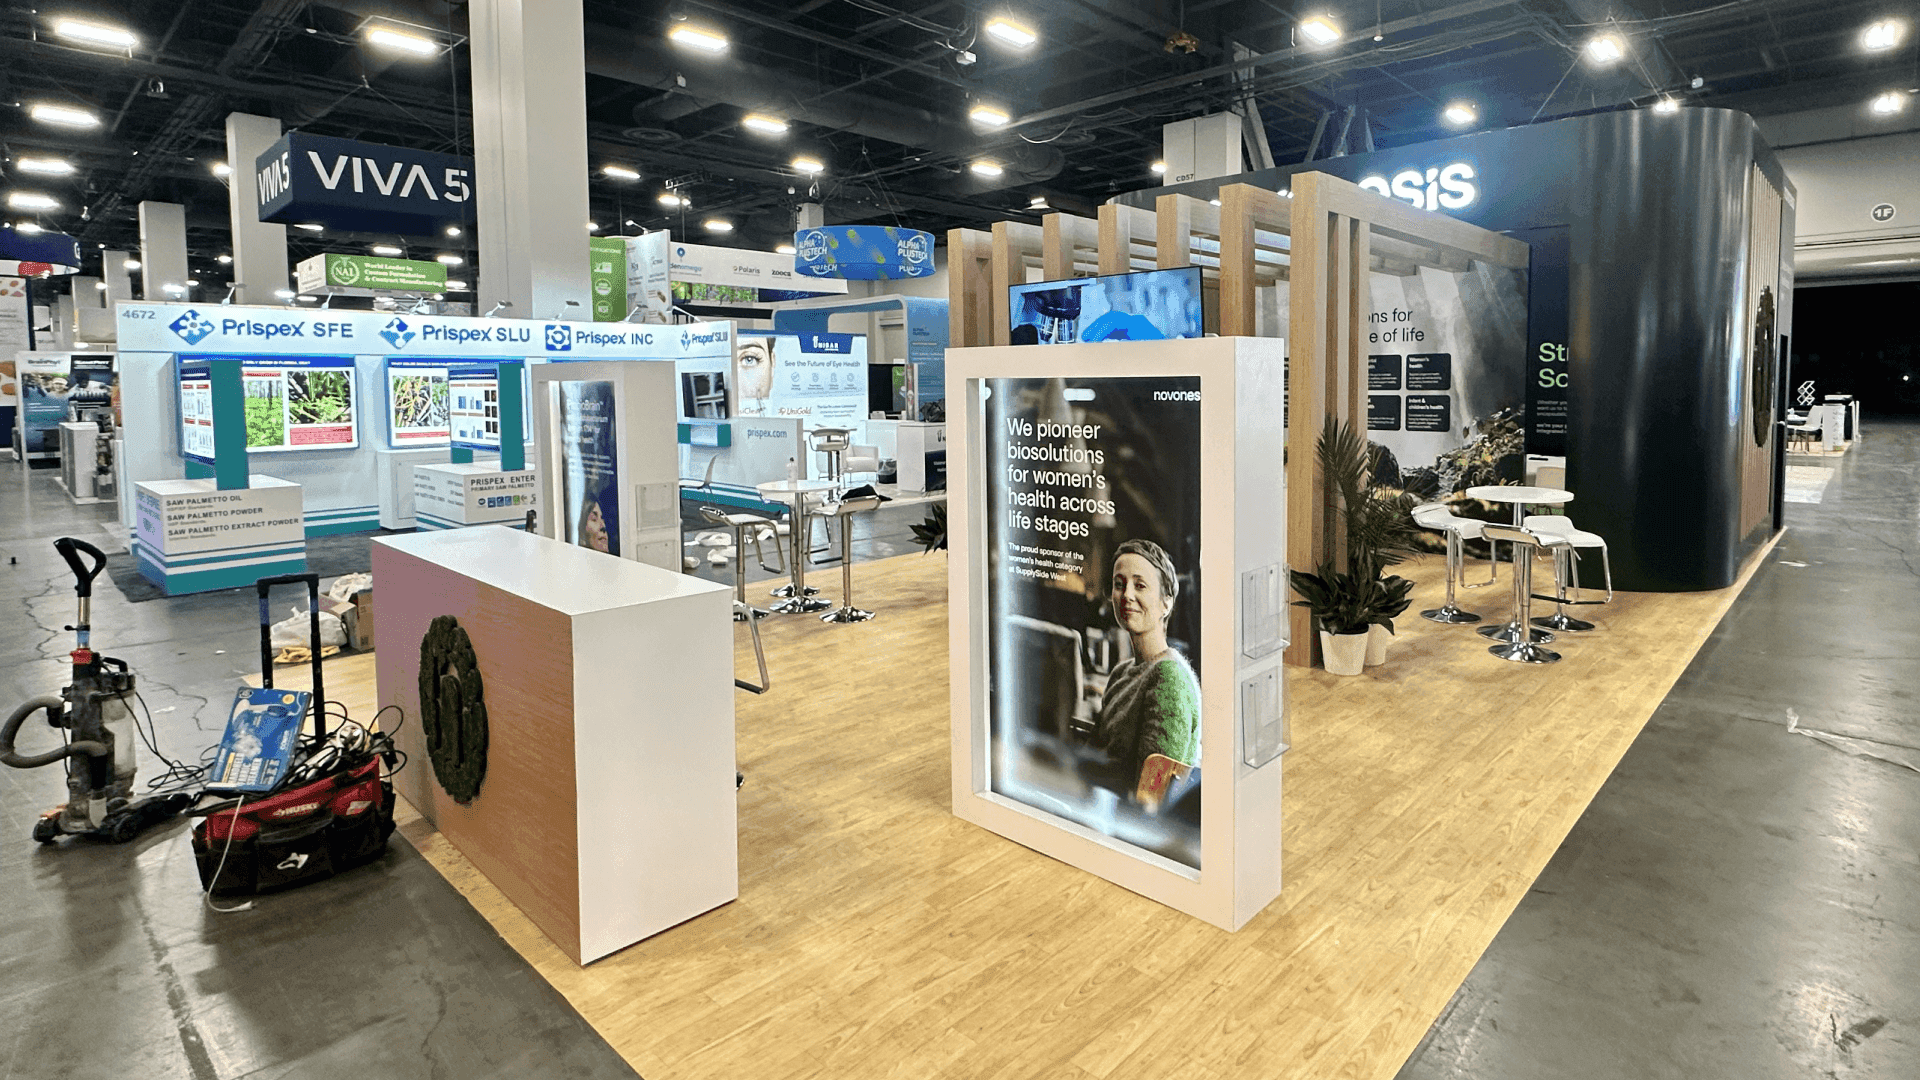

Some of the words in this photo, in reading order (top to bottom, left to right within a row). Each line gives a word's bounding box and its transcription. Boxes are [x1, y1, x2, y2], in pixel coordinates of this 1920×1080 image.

[1873, 207, 1893, 218] 1F
[897, 239, 920, 250] ALPHA
[897, 248, 928, 260] PLUSTECH
[738, 265, 761, 275] Polaris
[122, 309, 156, 320] 4672
[1392, 308, 1413, 323] for
[312, 321, 354, 339] SFE
[496, 326, 531, 342] SLU
[1383, 328, 1399, 343] of
[1402, 327, 1425, 342] life
[631, 332, 654, 345] INC
[832, 360, 842, 368] Eye
[747, 429, 788, 440] prispex.com
[1006, 417, 1033, 437] We
[1037, 419, 1101, 442] pioneer
[1007, 441, 1105, 464] biosolutions
[470, 476, 505, 487] PRISPEX
[510, 474, 536, 484] ENTER
[1007, 464, 1029, 483] for
[1033, 467, 1106, 490] women's
[166, 499, 184, 507] SAW
[186, 496, 228, 505] PALMETTO
[1008, 486, 1056, 510] health
[1060, 496, 1116, 515] across
[167, 514, 185, 522] SAW
[187, 510, 229, 519] PALMETTO
[230, 507, 263, 516] POWDER
[168, 529, 186, 537] SAW
[188, 525, 230, 534] PALMETTO
[231, 521, 266, 530] EXTRACT
[267, 518, 299, 527] POWDER
[1008, 510, 1031, 530] life
[1034, 515, 1089, 540] stages
[1008, 541, 1020, 551] The
[1020, 545, 1039, 554] proud
[1039, 548, 1064, 557] sponsor
[1065, 550, 1072, 558] of
[1072, 551, 1084, 561] the
[1008, 554, 1035, 565] women's
[1035, 557, 1054, 568] health
[1054, 561, 1083, 574] category
[1015, 566, 1050, 578] SupplySide
[1050, 571, 1067, 581] West
